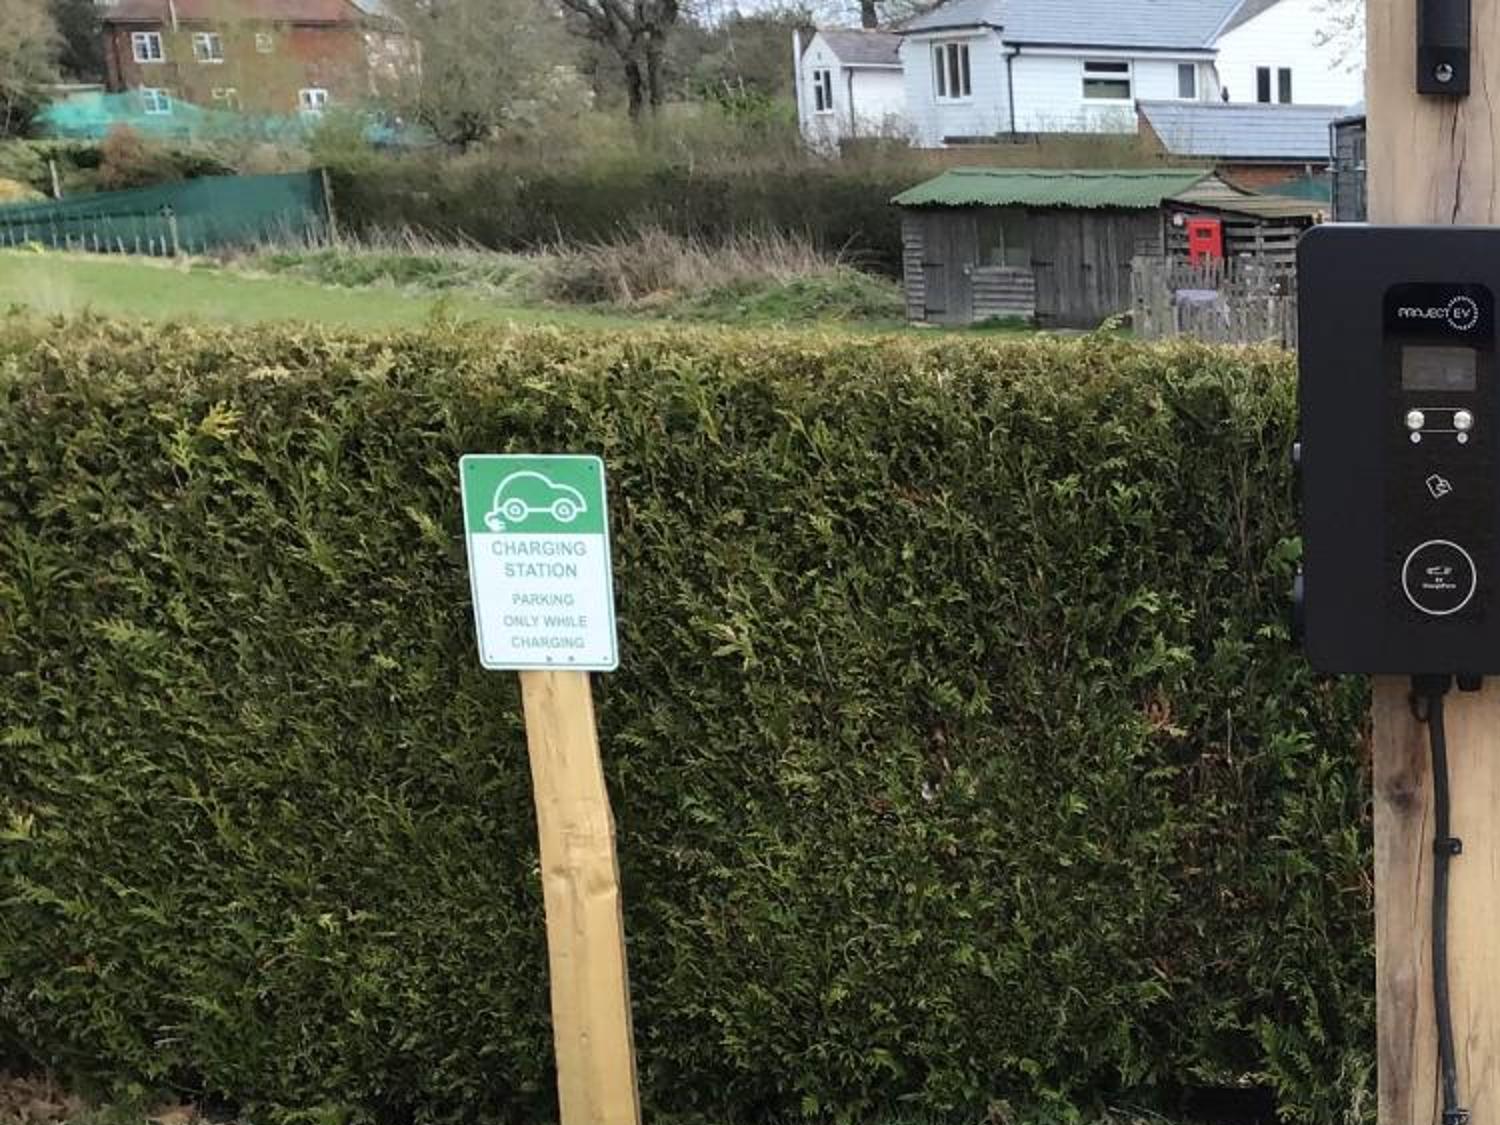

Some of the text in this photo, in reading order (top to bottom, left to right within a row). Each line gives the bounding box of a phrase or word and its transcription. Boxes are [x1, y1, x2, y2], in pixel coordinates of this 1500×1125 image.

[1397, 306, 1471, 319] PROJECT EV
[491, 540, 588, 557] CHARGING
[504, 562, 577, 578] STATION
[512, 593, 574, 607] PARKING
[503, 615, 588, 628] ONLY WHILE
[511, 636, 585, 649] CHARGING
